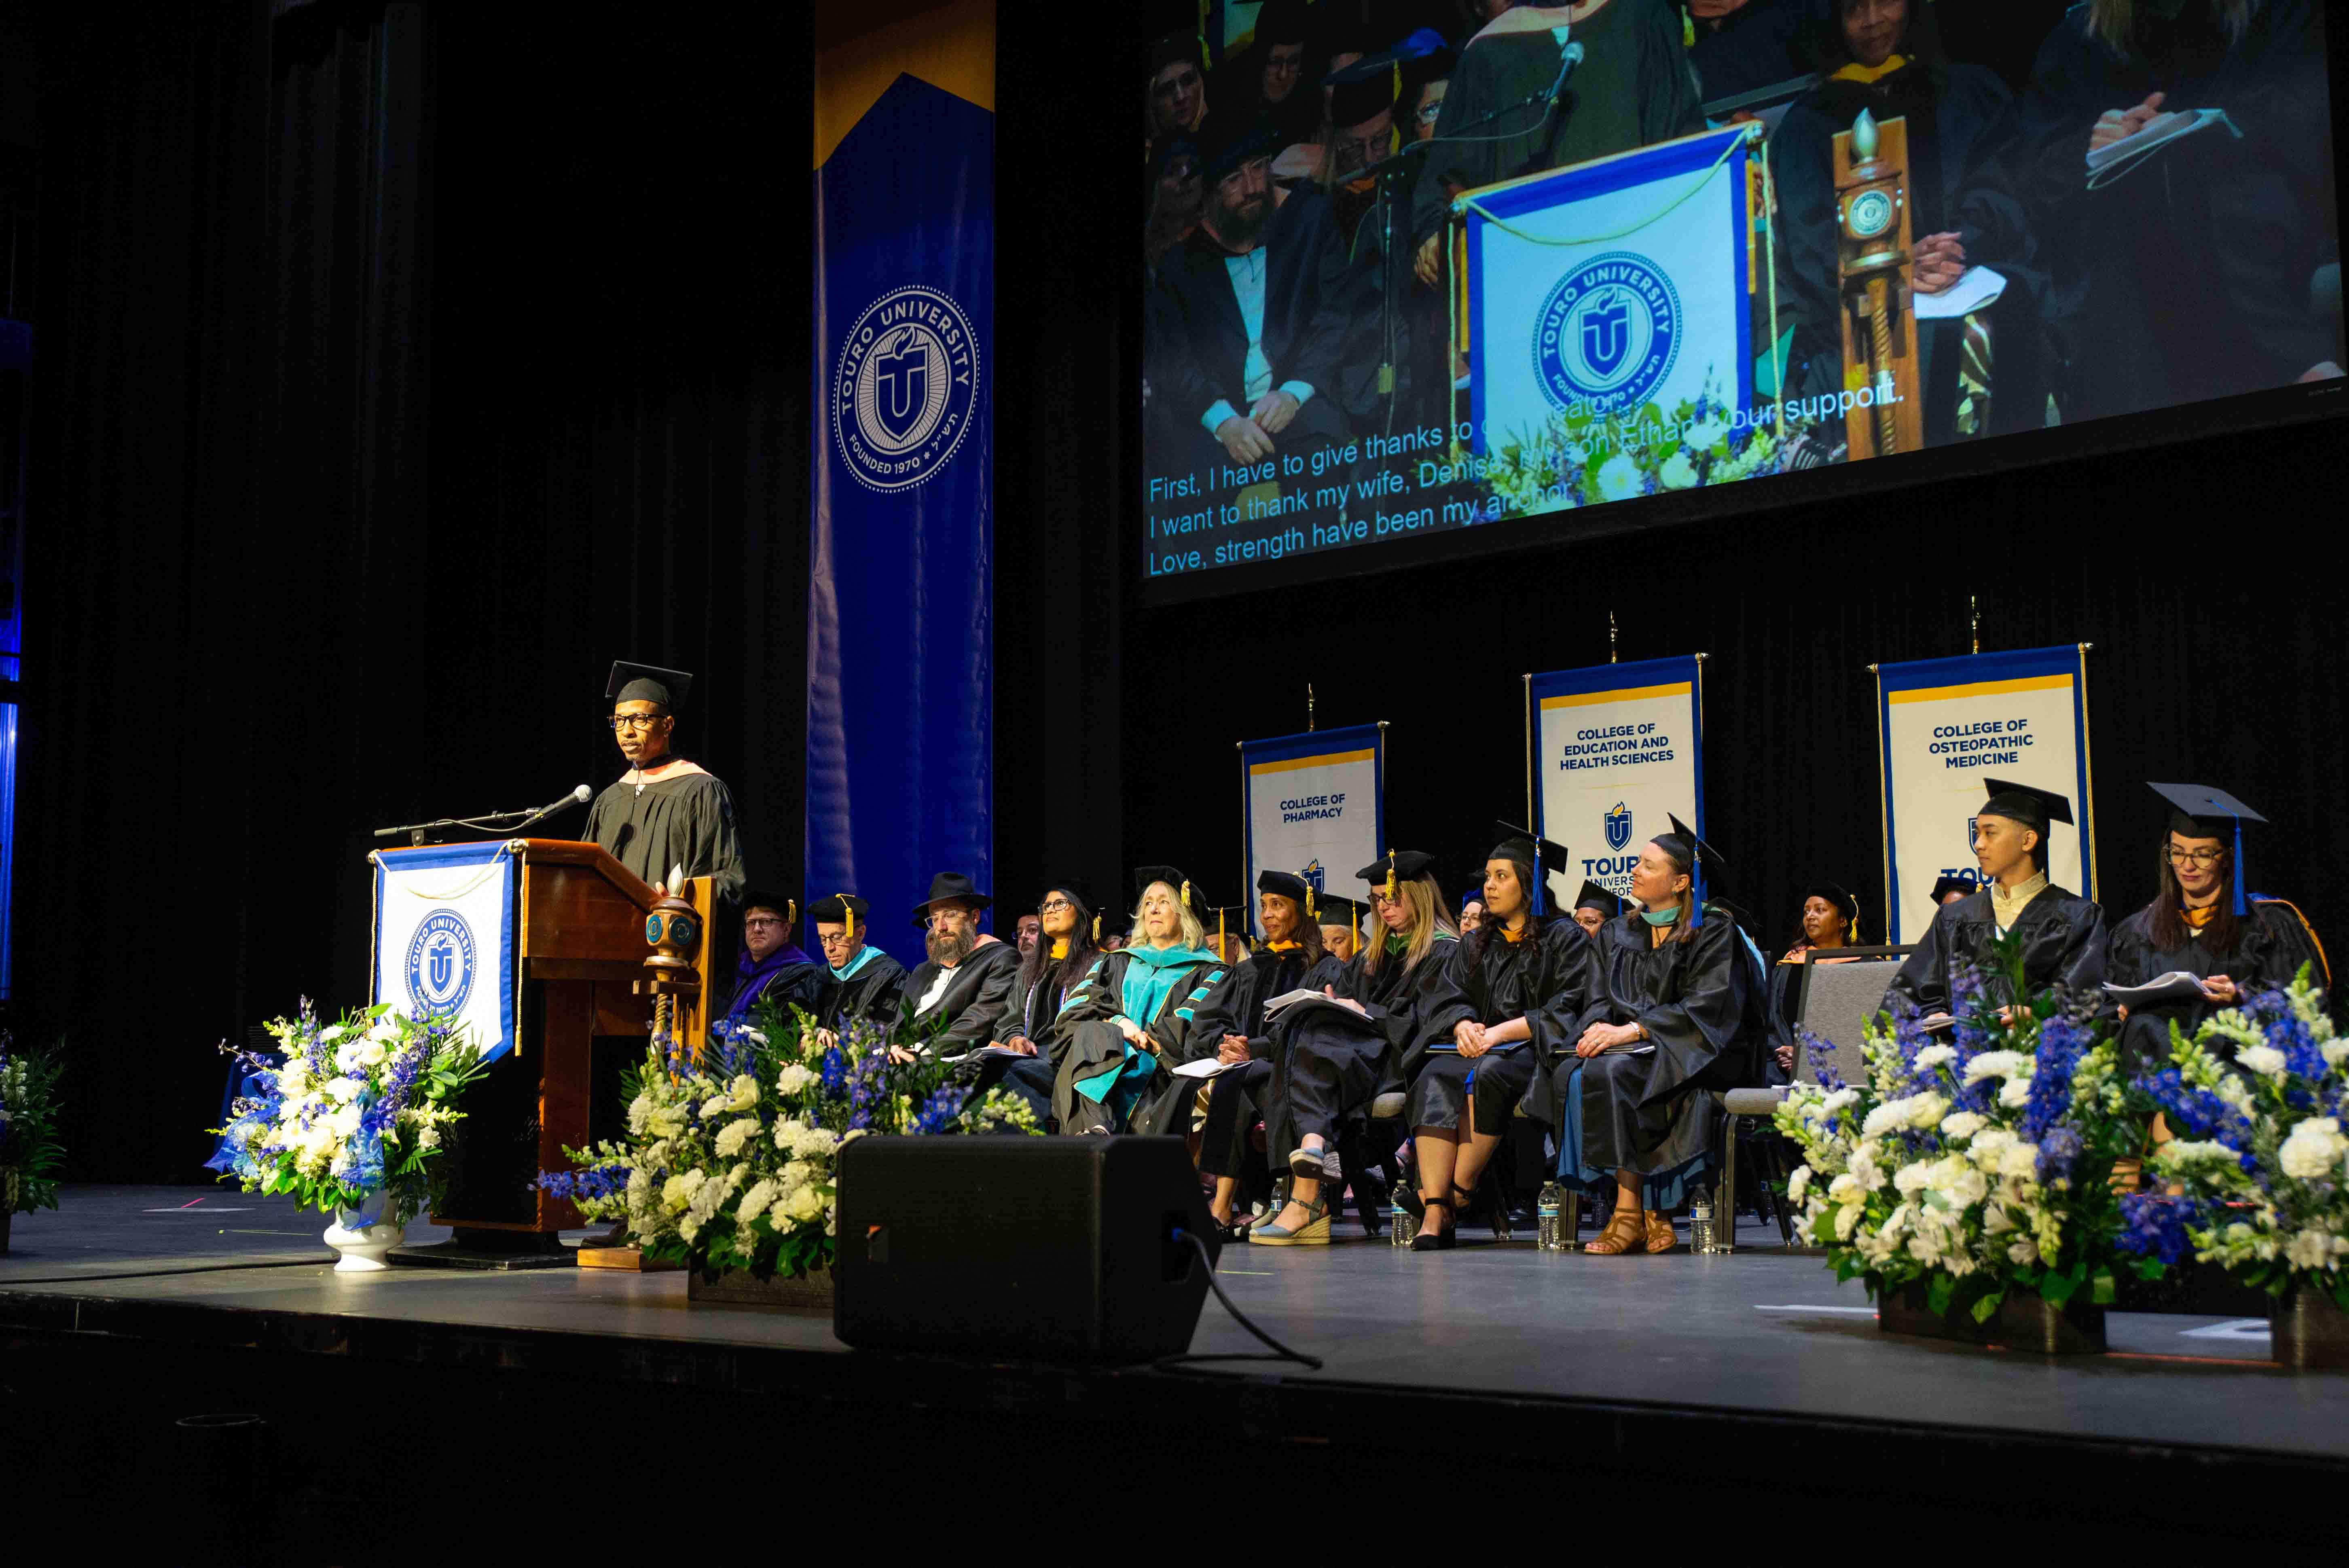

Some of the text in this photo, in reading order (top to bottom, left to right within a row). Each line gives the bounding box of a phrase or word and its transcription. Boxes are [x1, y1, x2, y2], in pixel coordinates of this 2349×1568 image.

[1543, 266, 1670, 359] TOURO UNIVERSITY
[842, 301, 969, 415] TOURO UNIVERSITY
[850, 434, 921, 474] FOUNDED 1970
[1150, 472, 1200, 502] First,
[1210, 467, 1214, 491] I
[1223, 465, 1275, 488] have
[1282, 454, 1304, 476] to
[1311, 444, 1358, 476] give
[1365, 425, 1443, 459] thanks
[1151, 515, 1154, 539] I
[1162, 506, 1213, 537] want
[1220, 504, 1240, 525] to
[1248, 487, 1309, 521] thank
[1316, 484, 1350, 510] my
[1357, 470, 1410, 499] wife,
[1785, 376, 1904, 422] support.
[1150, 550, 1207, 576] Love,
[1215, 527, 1305, 564] strength
[1312, 523, 1368, 547] have
[1376, 510, 1434, 535] been
[1443, 498, 1478, 526] my
[1577, 723, 1655, 741] COLLEGE OF
[1933, 719, 2027, 738] COLLEGE OF
[1564, 736, 1669, 756] EDUCATION AND
[1929, 734, 2034, 754] OSTEOPATHIC
[1560, 750, 1674, 770] HEALTH SCIENCES
[1946, 751, 2019, 768] MEDICINE
[1280, 794, 1345, 810] COLLEGE OF
[1283, 807, 1342, 823] PHARMACY
[1941, 867, 1994, 886] TOU
[411, 918, 472, 974] TOURO UNIVERSITY
